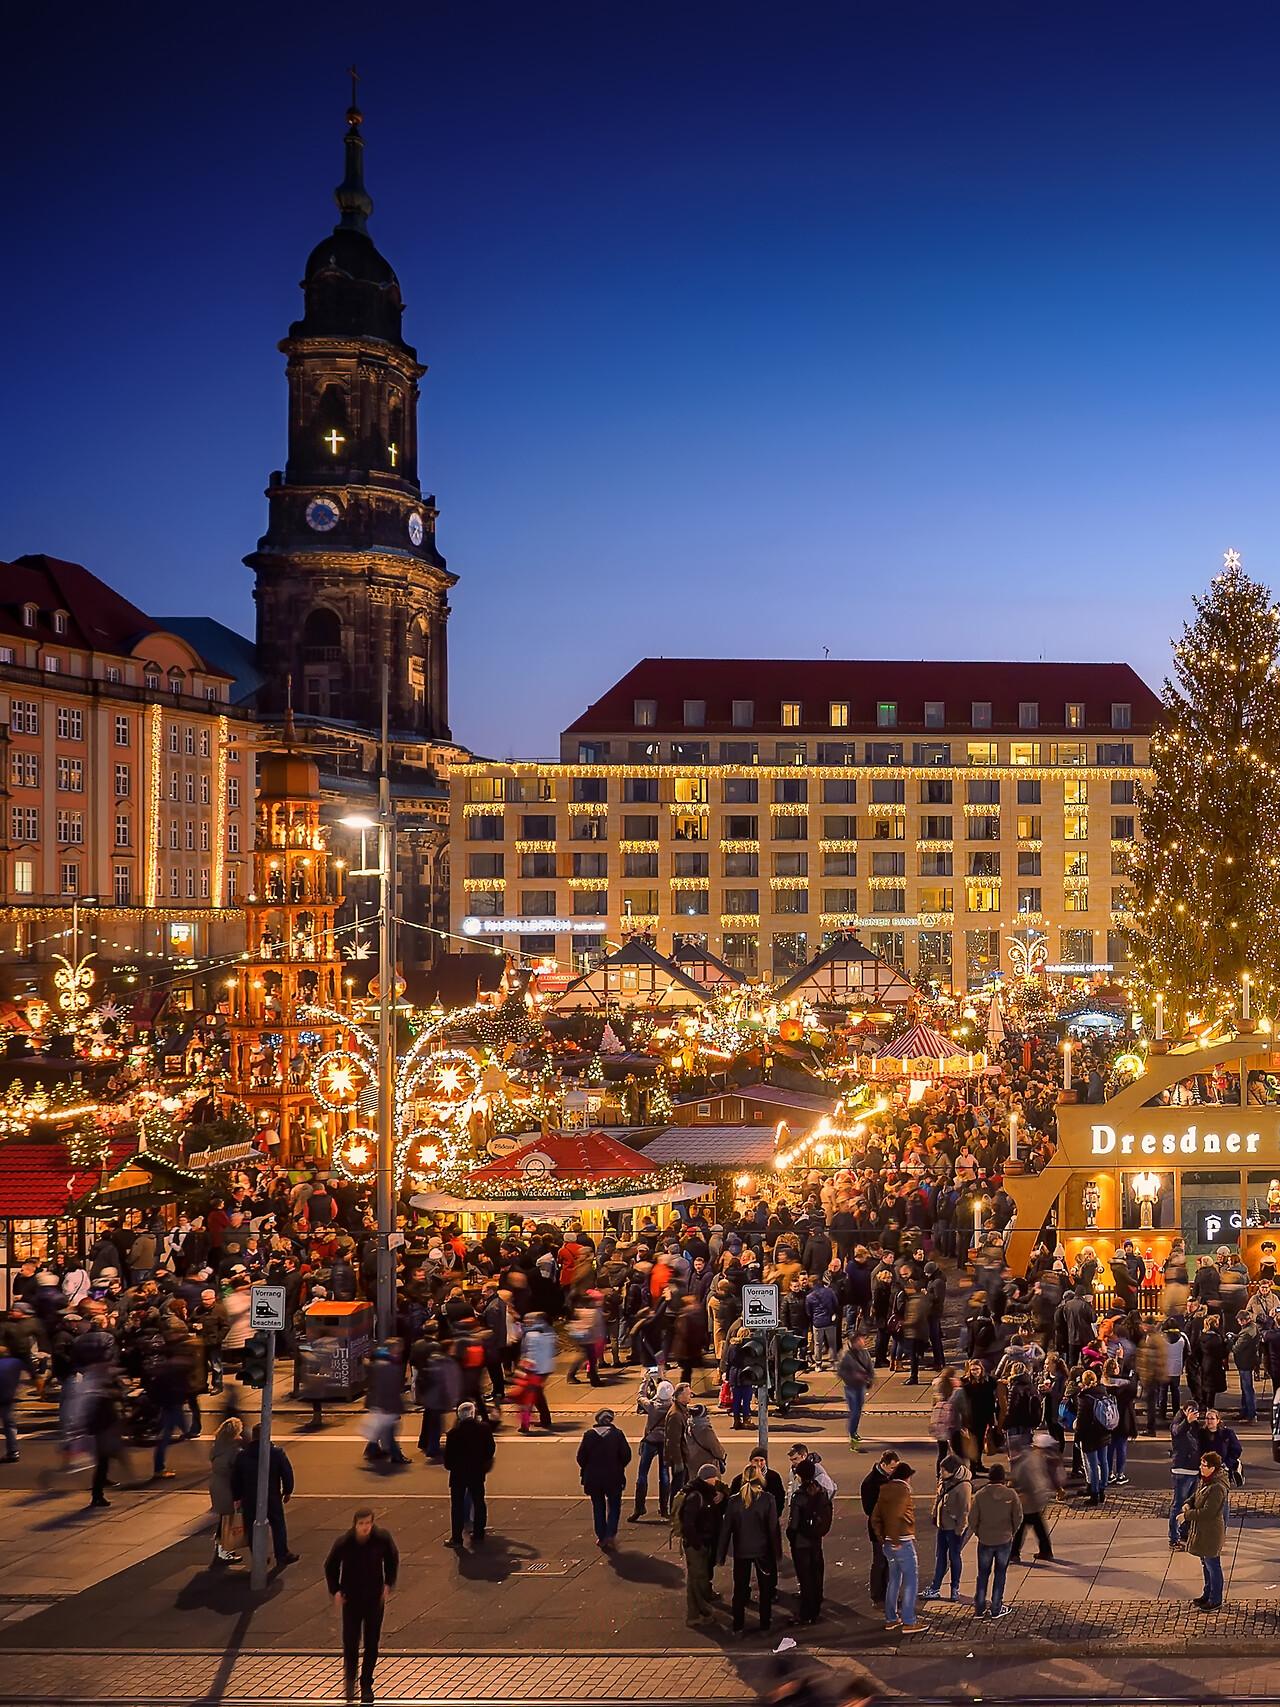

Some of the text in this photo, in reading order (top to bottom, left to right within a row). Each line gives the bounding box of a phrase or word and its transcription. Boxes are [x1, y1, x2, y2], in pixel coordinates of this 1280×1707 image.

[1090, 1125, 1260, 1154] Dresdner
[255, 1290, 282, 1298] Vorrang
[747, 1288, 774, 1296] Vorrang
